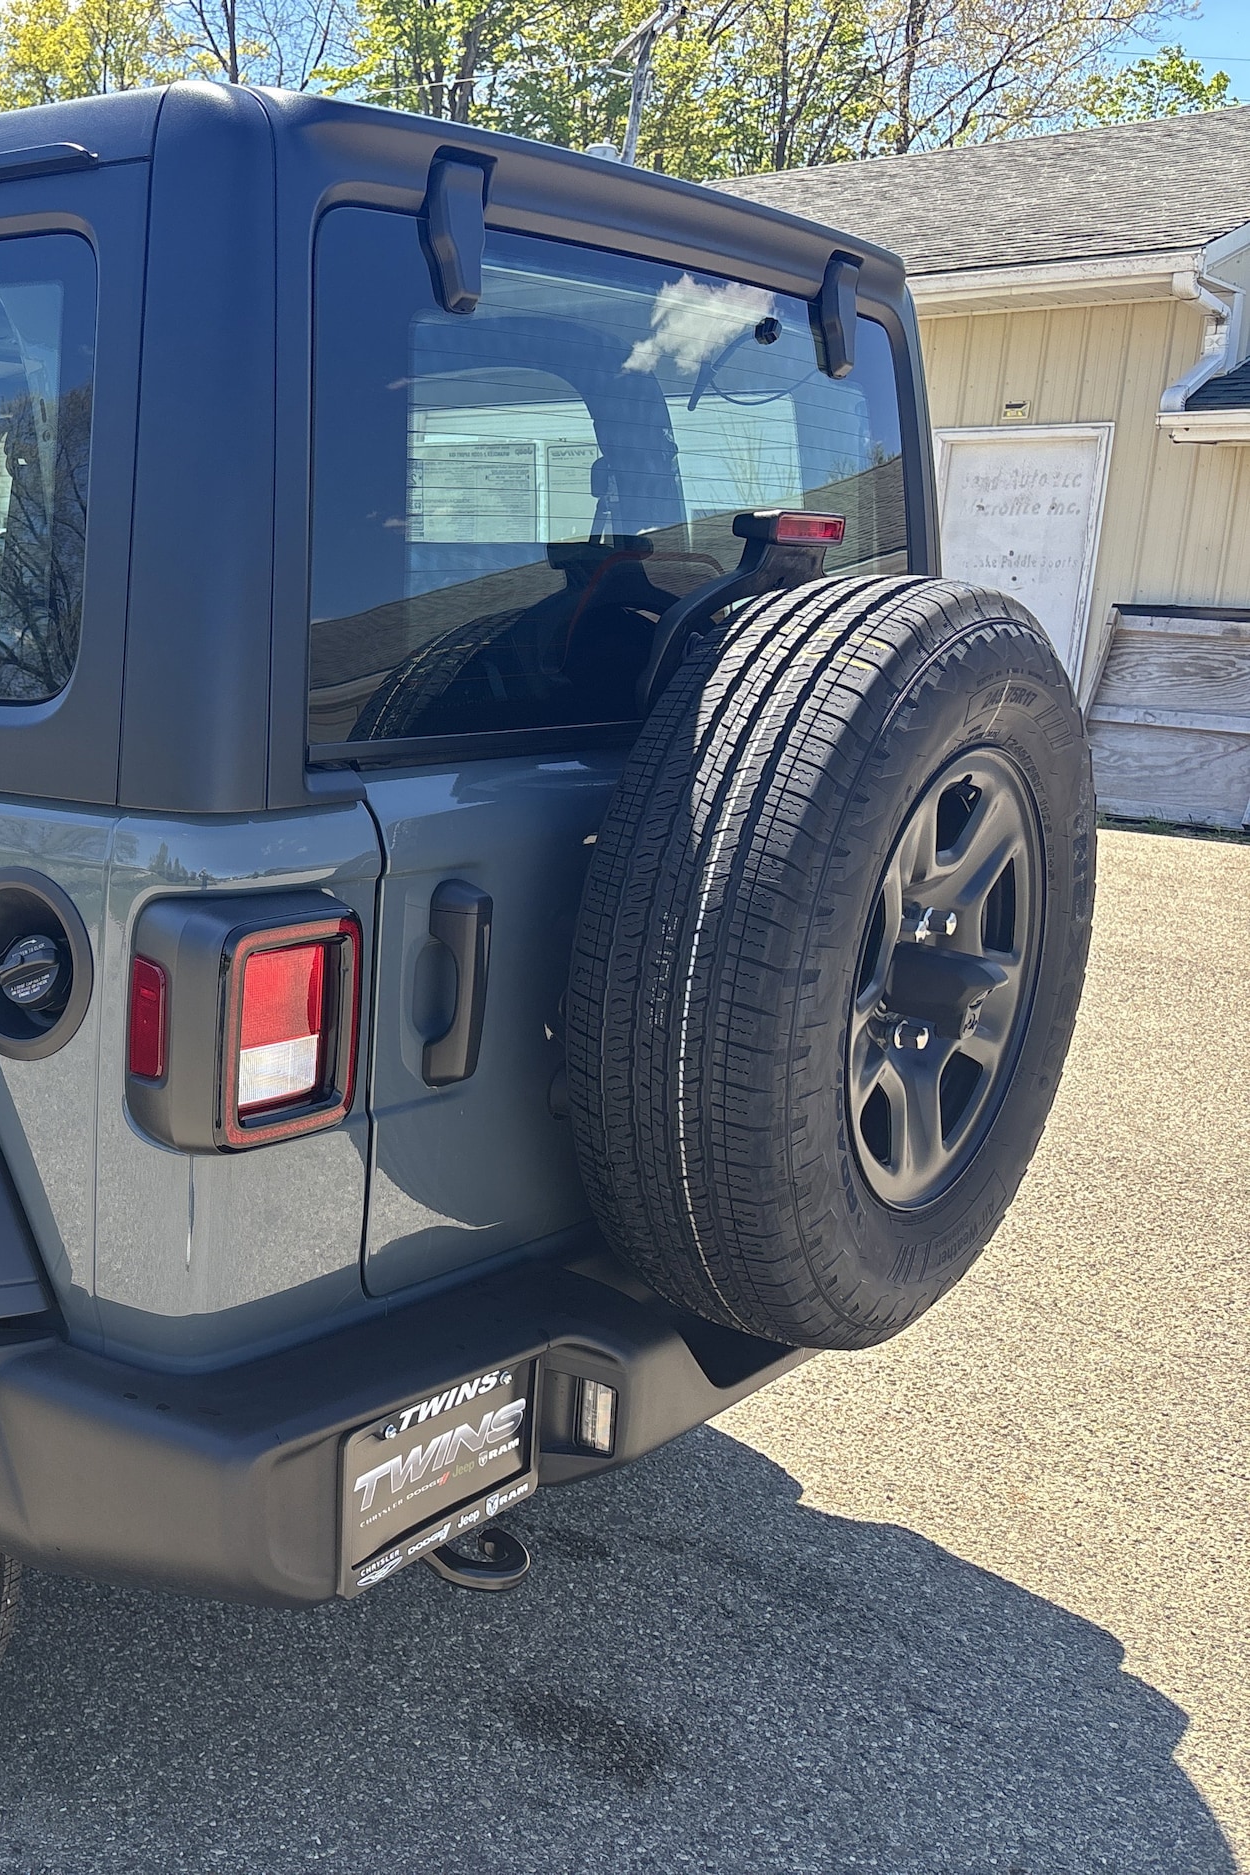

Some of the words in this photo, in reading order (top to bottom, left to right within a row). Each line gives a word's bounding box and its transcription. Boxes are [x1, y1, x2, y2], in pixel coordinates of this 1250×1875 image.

[400, 1370, 500, 1432] TWINS
[354, 1398, 527, 1512] TWINS
[359, 1499, 404, 1529] CHRYSLER
[406, 1477, 444, 1501] DODGE
[452, 1460, 475, 1478] Jeep
[488, 1437, 520, 1460] RAM
[360, 1548, 401, 1577] CHRYSLER
[407, 1529, 445, 1556] DODGE
[457, 1510, 480, 1529] Jeep
[499, 1482, 529, 1506] RAM
